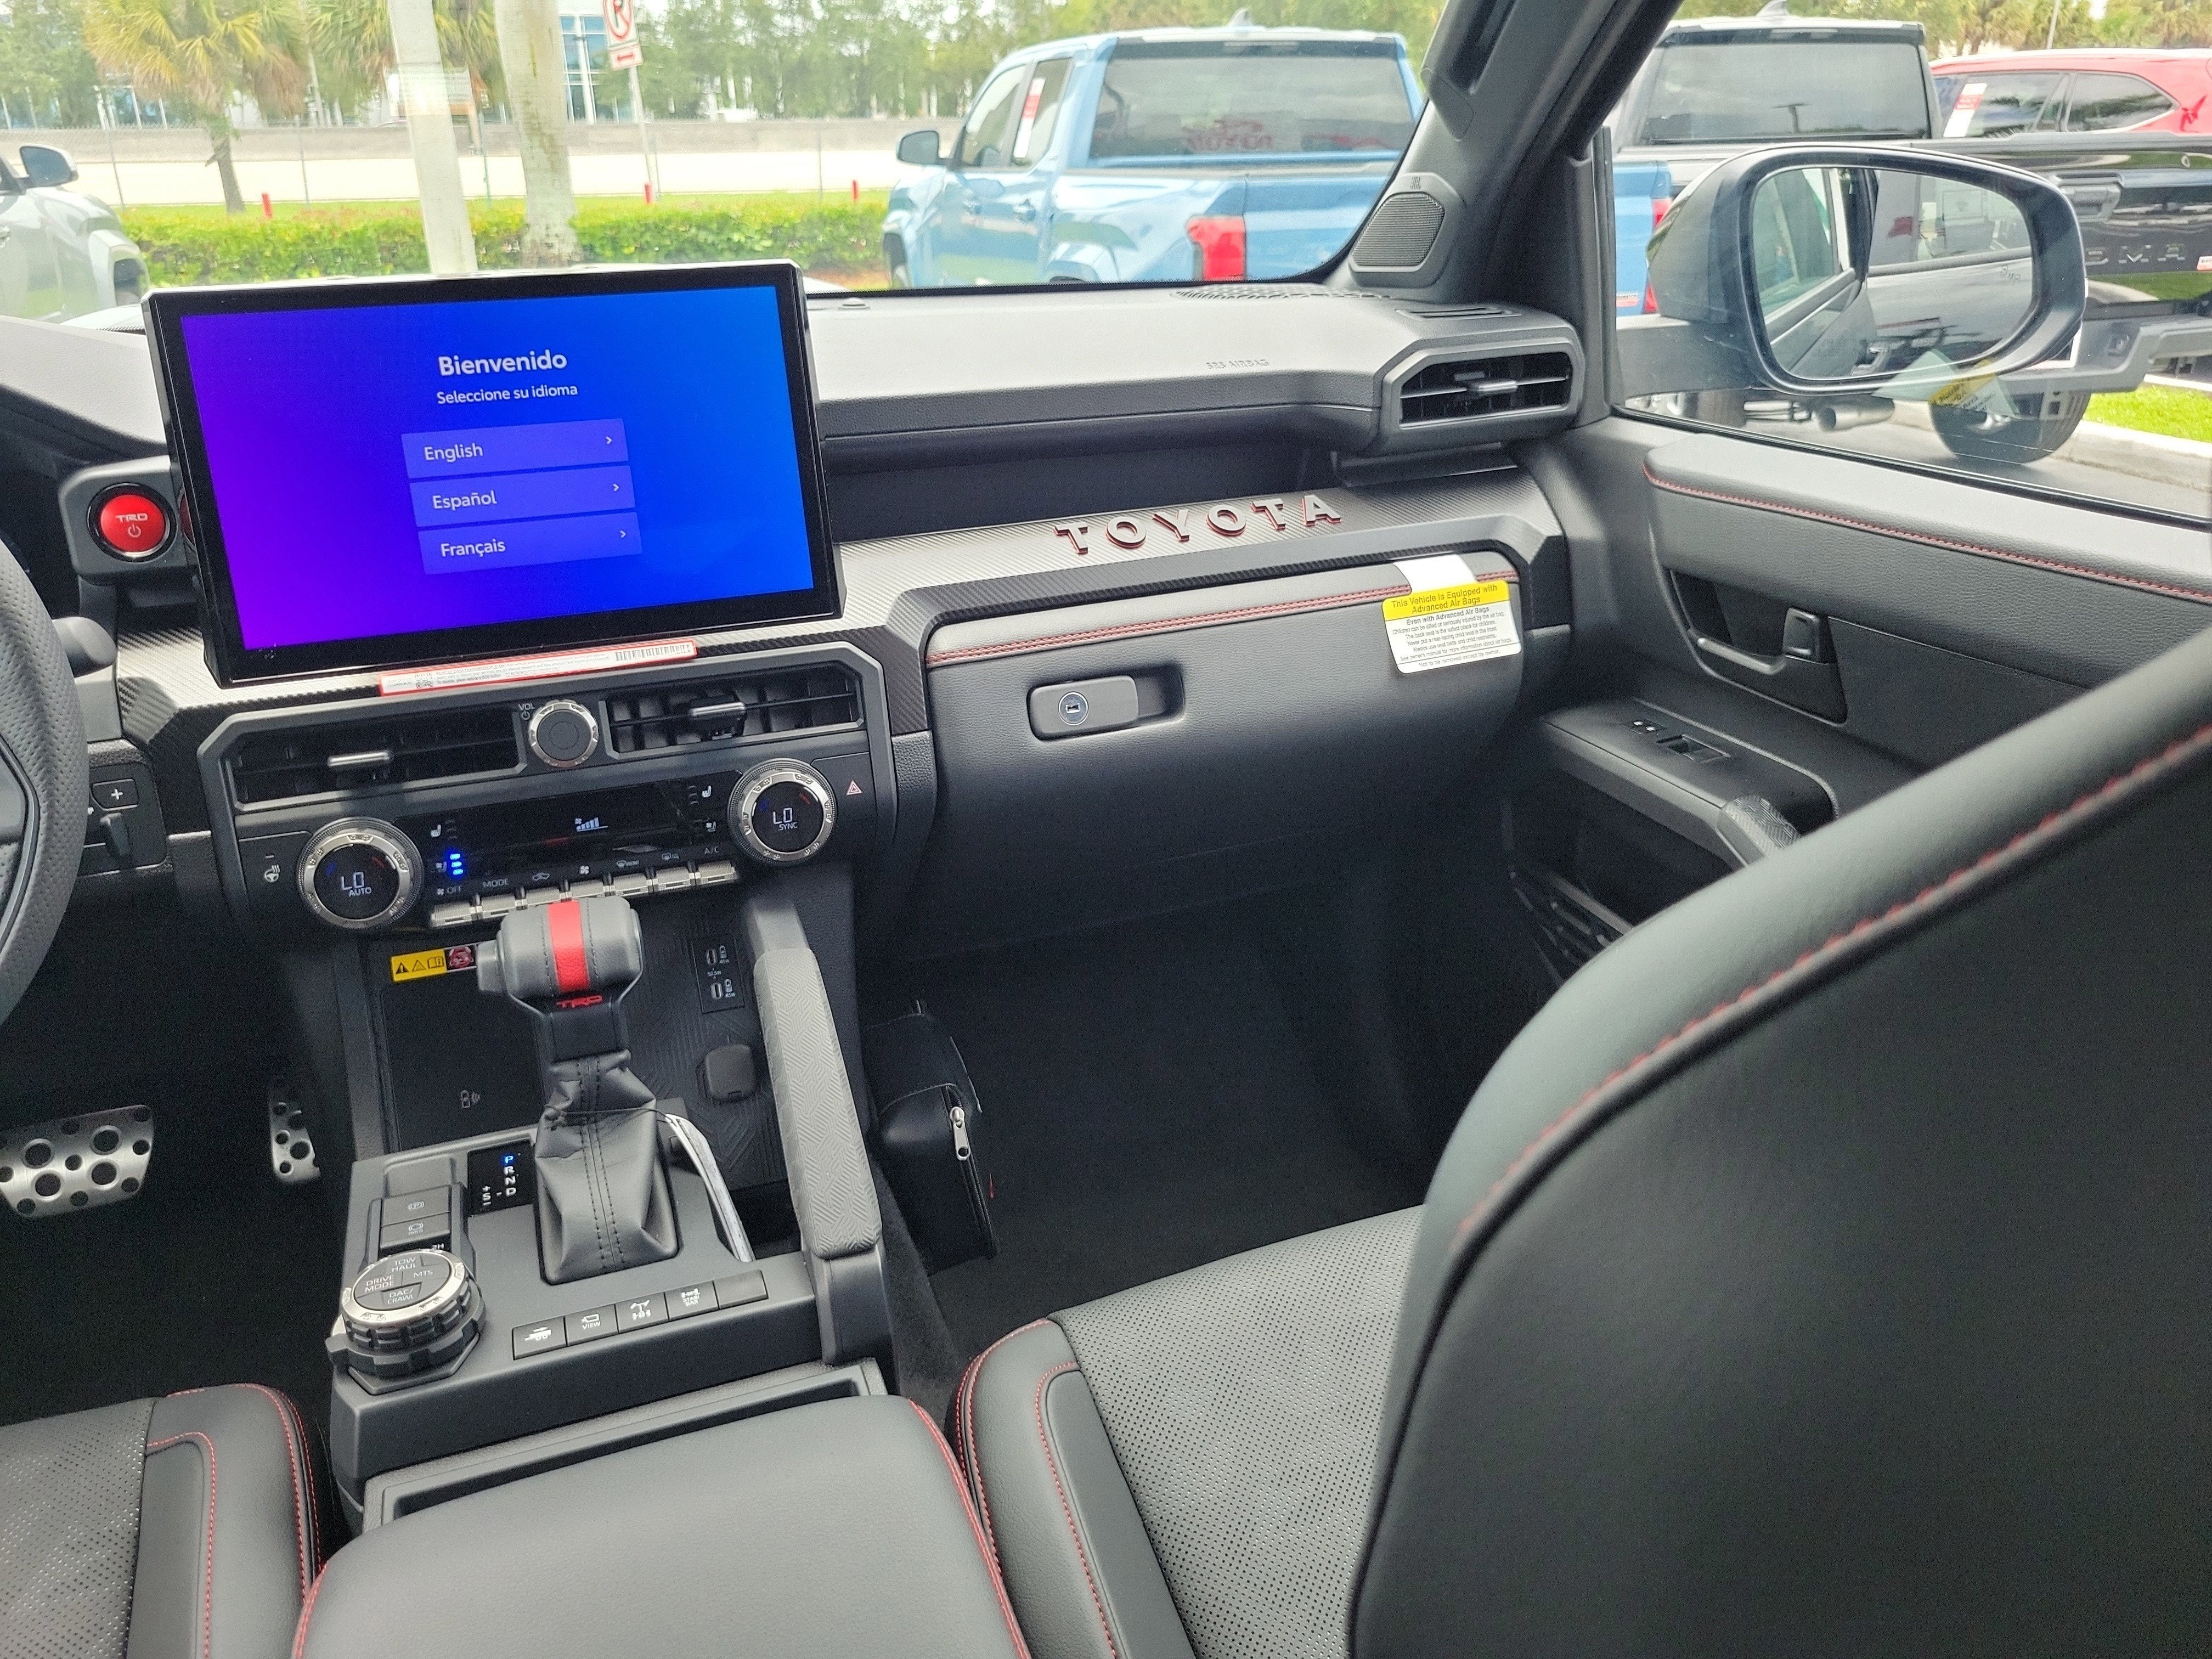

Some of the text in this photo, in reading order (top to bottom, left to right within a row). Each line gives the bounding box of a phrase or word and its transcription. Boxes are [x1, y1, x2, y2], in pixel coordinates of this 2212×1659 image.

[438, 349, 567, 376] Bienvenido
[437, 384, 578, 404] Seleccione su idioma
[424, 443, 483, 463] English
[433, 490, 497, 511] Español
[115, 513, 148, 523] TRD
[1054, 495, 1341, 555] TOYOTA
[441, 539, 506, 557] Français
[1391, 600, 1408, 608] This
[1409, 595, 1436, 605] Vehicle
[1447, 588, 1481, 600] Equipped
[1482, 584, 1497, 592] with
[1412, 596, 1481, 614] Advanced Air Bags
[1436, 611, 1464, 620] Advanced
[772, 807, 793, 825] LO
[778, 822, 798, 831] SYNC
[341, 871, 364, 890] LO
[483, 878, 509, 888] MODE
[349, 887, 372, 897] AUTO
[447, 885, 462, 894] OFF
[556, 995, 602, 1008] TRD
[505, 1155, 514, 1164] P
[504, 1166, 515, 1175] R
[505, 1176, 516, 1186] N
[482, 1192, 491, 1201] S
[505, 1187, 516, 1197] D
[395, 1257, 416, 1266] TOW
[392, 1263, 416, 1272] HAUL
[414, 1269, 433, 1278] MTS
[366, 1274, 394, 1286] DRIVE
[365, 1281, 394, 1293] MODE
[390, 1288, 414, 1299] DAC/
[387, 1295, 413, 1304] CRAWL
[582, 1321, 601, 1329] VIEW
